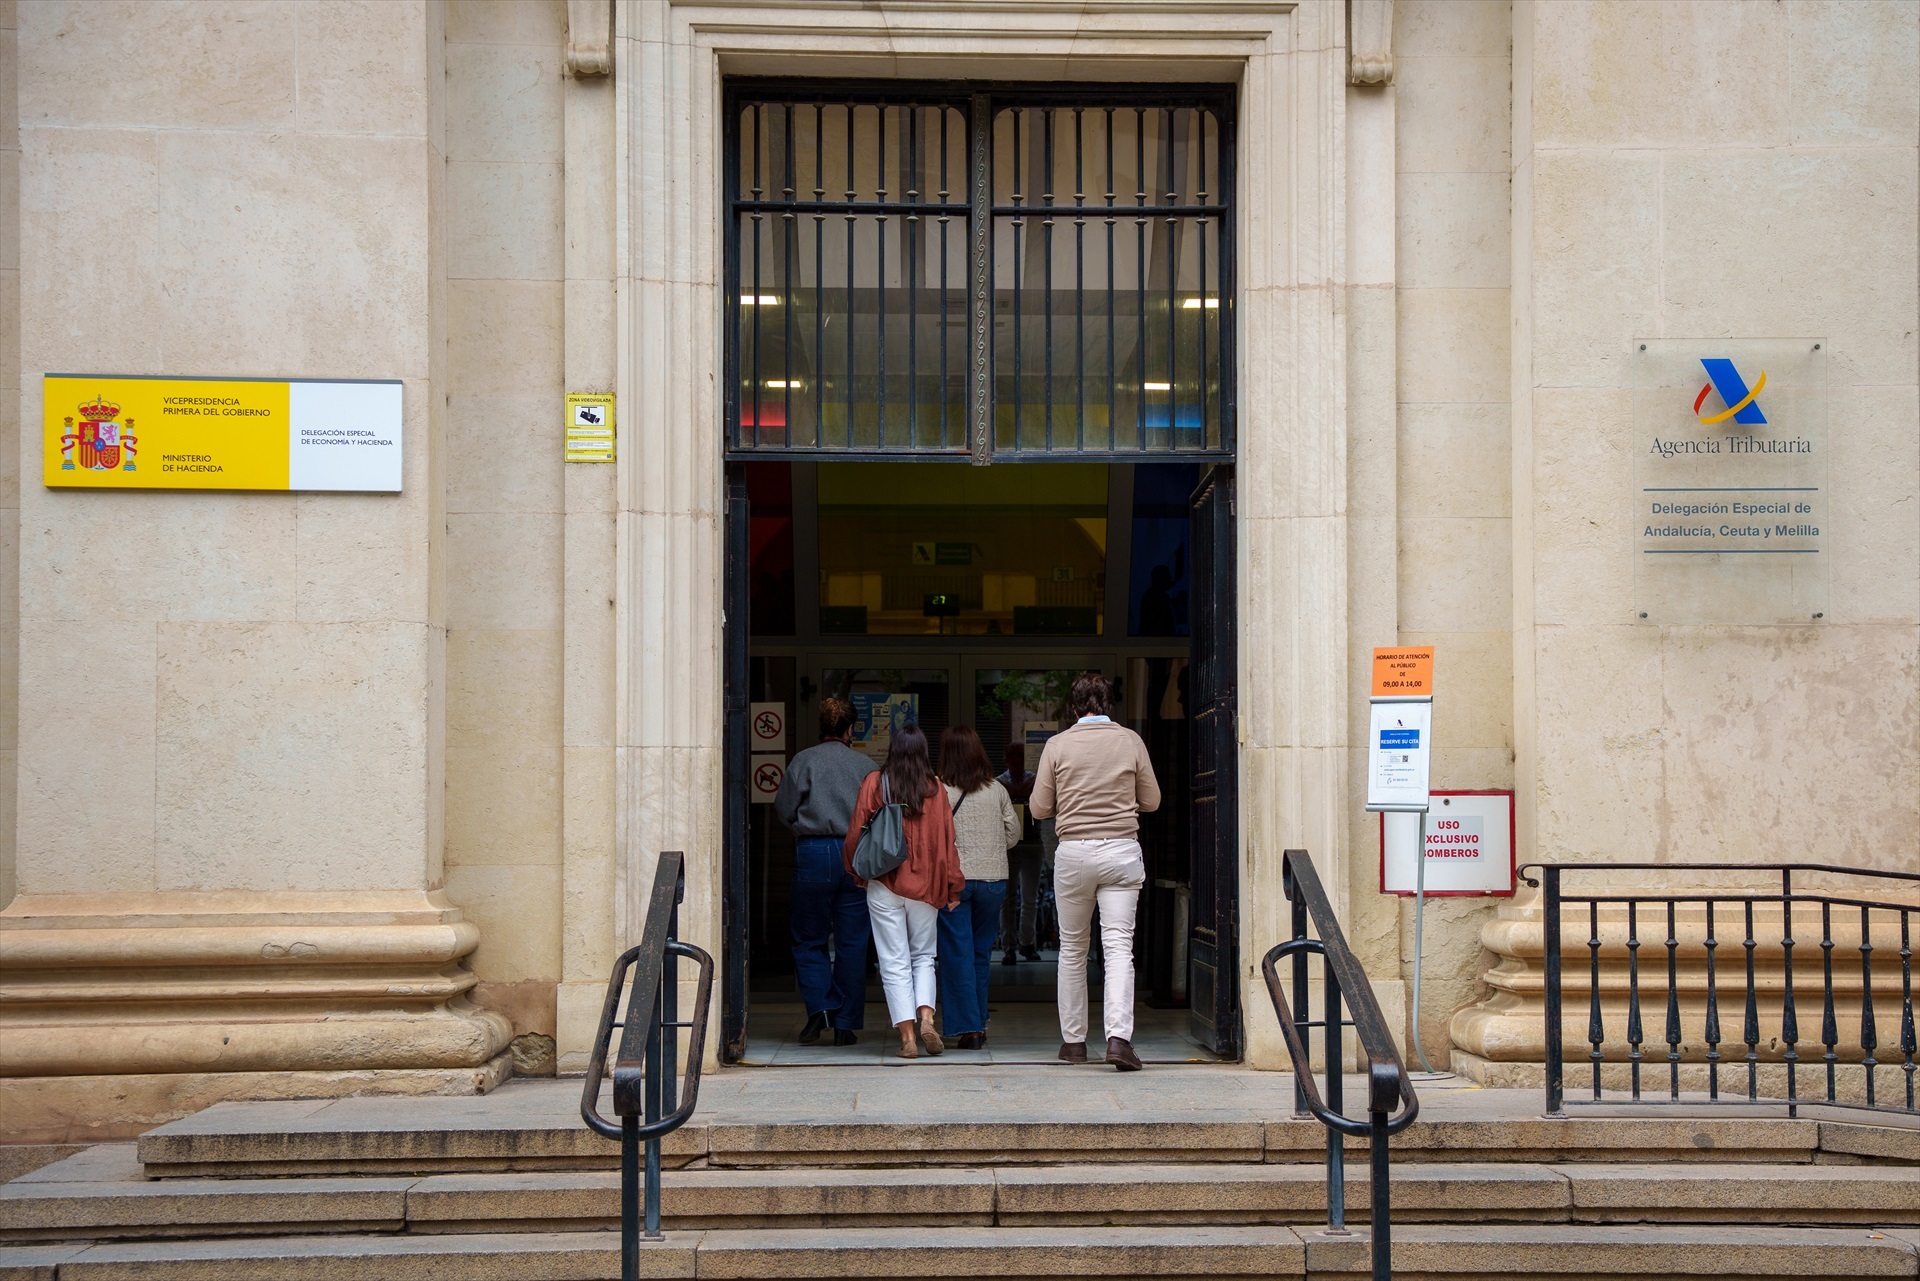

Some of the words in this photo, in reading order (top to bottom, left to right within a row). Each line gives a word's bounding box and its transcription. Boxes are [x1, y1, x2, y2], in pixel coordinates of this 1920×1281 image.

[163, 397, 240, 406] VICEPRESIDENCIA
[163, 407, 200, 415] PRIMERA
[203, 408, 220, 416] DEL
[222, 408, 270, 417] GOBIERNO
[301, 428, 345, 436] DELEGACIÓN
[1650, 436, 1721, 459] Agencia
[1725, 435, 1811, 454] Tributaria
[162, 454, 212, 462] MINISTERIO
[1652, 502, 1728, 517] Delegación
[1732, 502, 1790, 516] Especial
[1794, 503, 1811, 514] de
[1644, 526, 1716, 538] Andalucía,
[1719, 525, 1760, 536] Ceuta
[1764, 528, 1772, 538] y
[1776, 525, 1819, 536] Melilla
[1056, 568, 1070, 580] 31
[1438, 820, 1460, 830] USO
[1426, 834, 1479, 844] XCLUSIVO
